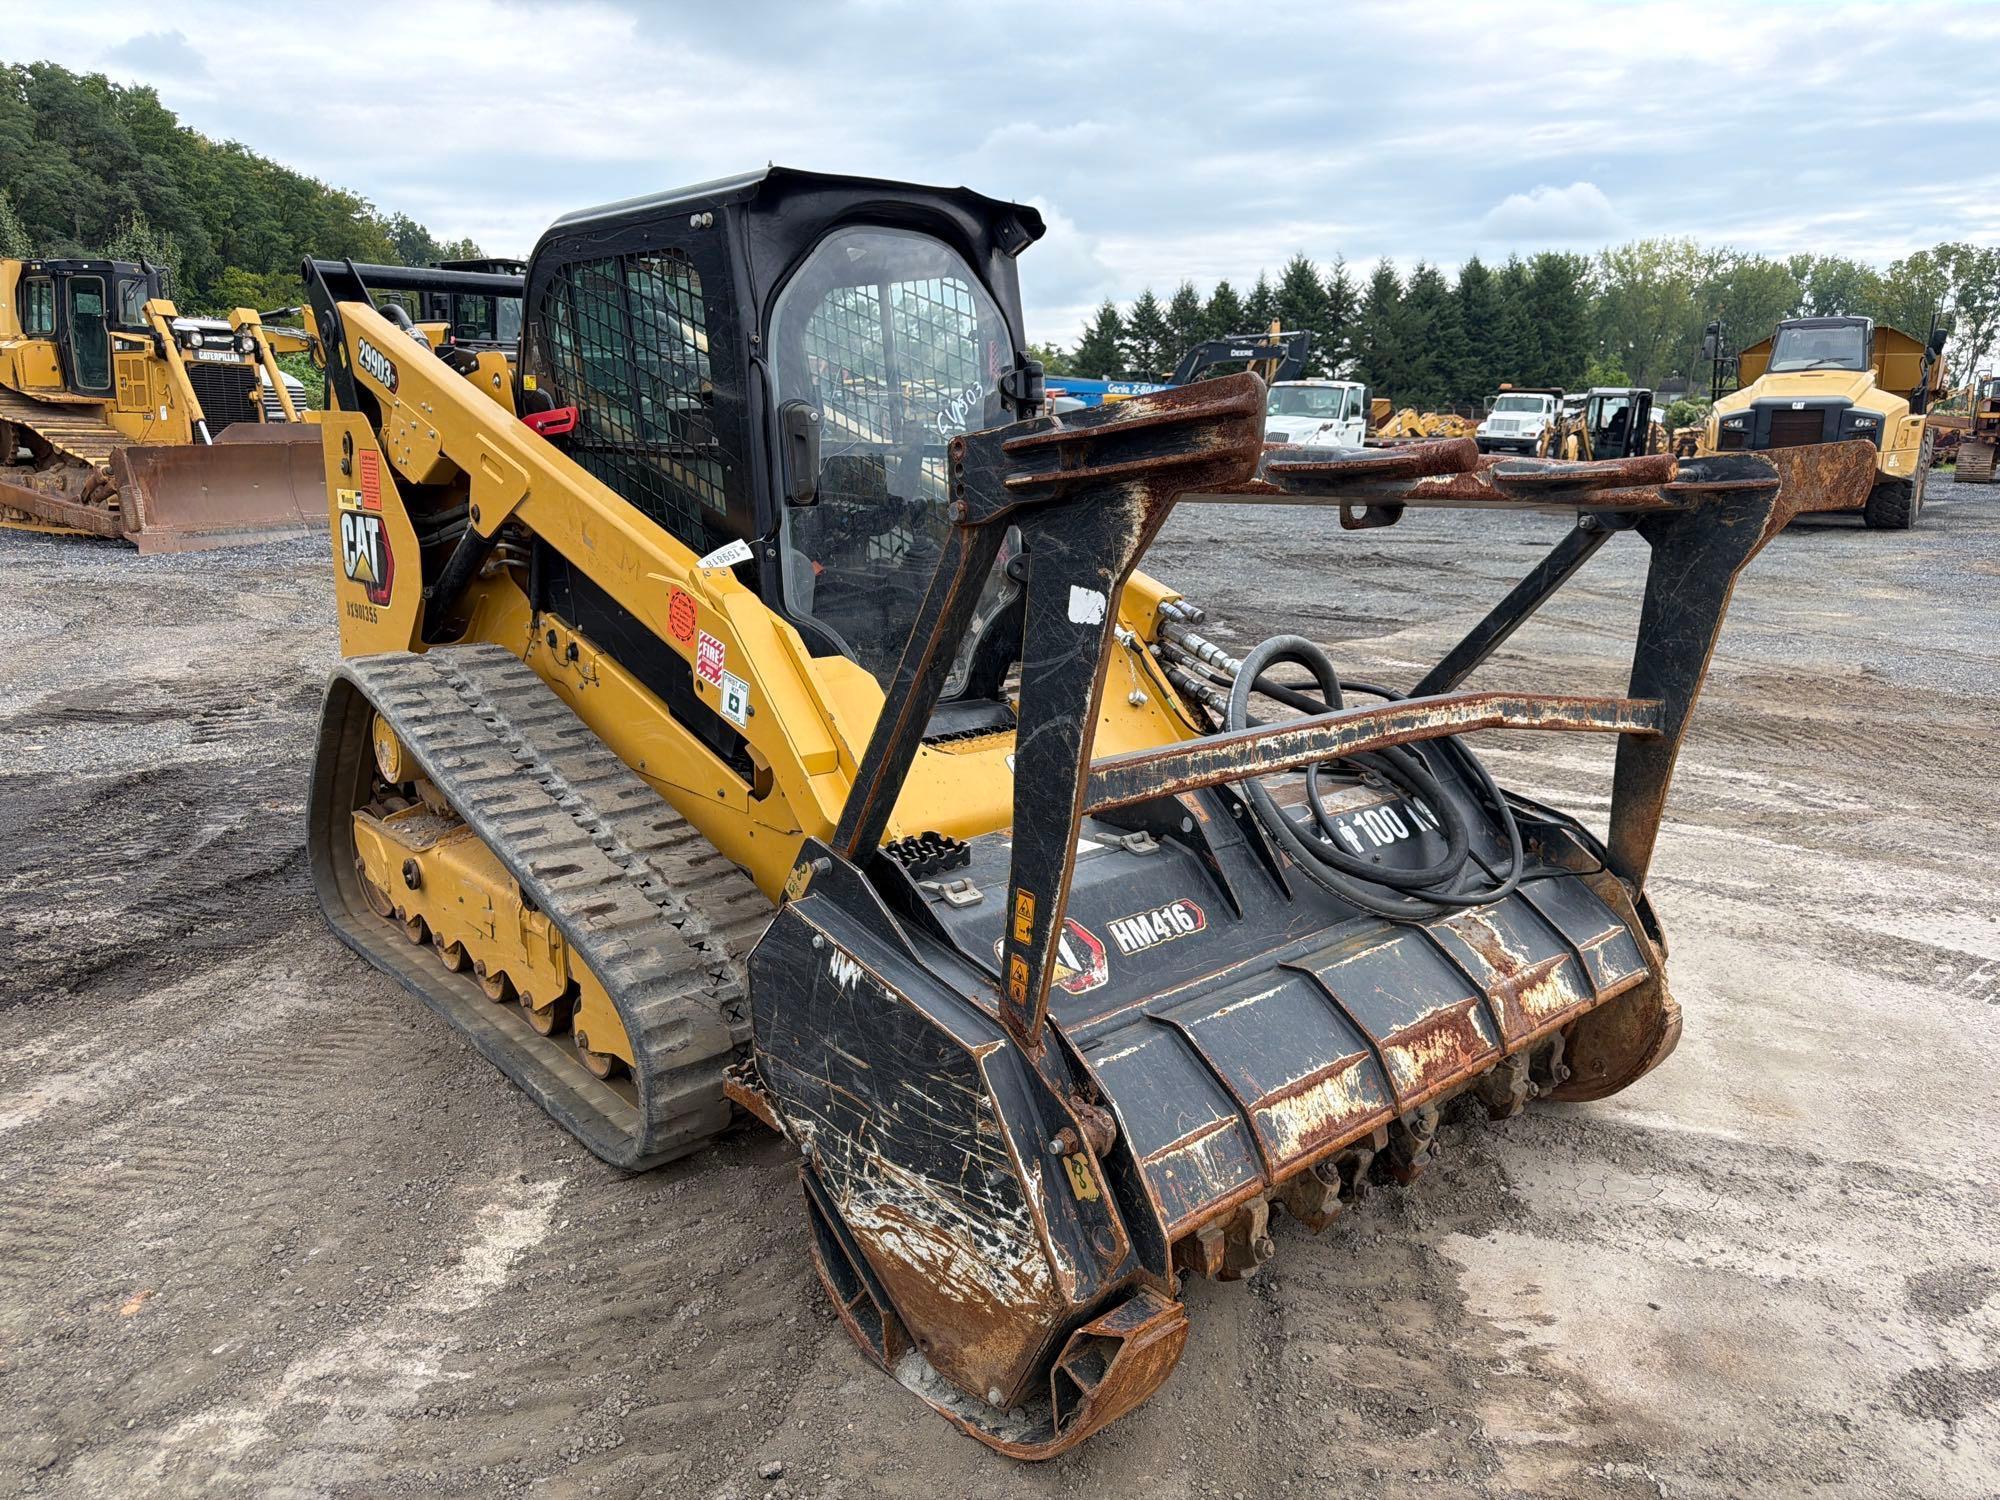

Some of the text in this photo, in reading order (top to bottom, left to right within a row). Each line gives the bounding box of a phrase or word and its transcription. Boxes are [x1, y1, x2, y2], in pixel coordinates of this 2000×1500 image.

[199, 351, 240, 362] CATERPILLAR
[1230, 349, 1254, 357] DEERE
[358, 338, 391, 388] 299D3
[1107, 383, 1130, 394] Genie
[341, 512, 379, 584] CAT
[705, 549, 741, 568] 159818
[702, 641, 720, 664] FIRE
[724, 674, 747, 693] FIRST AID
[731, 686, 740, 694] KIT
[1353, 805, 1410, 847] 100
[1109, 903, 1195, 953] HM416
